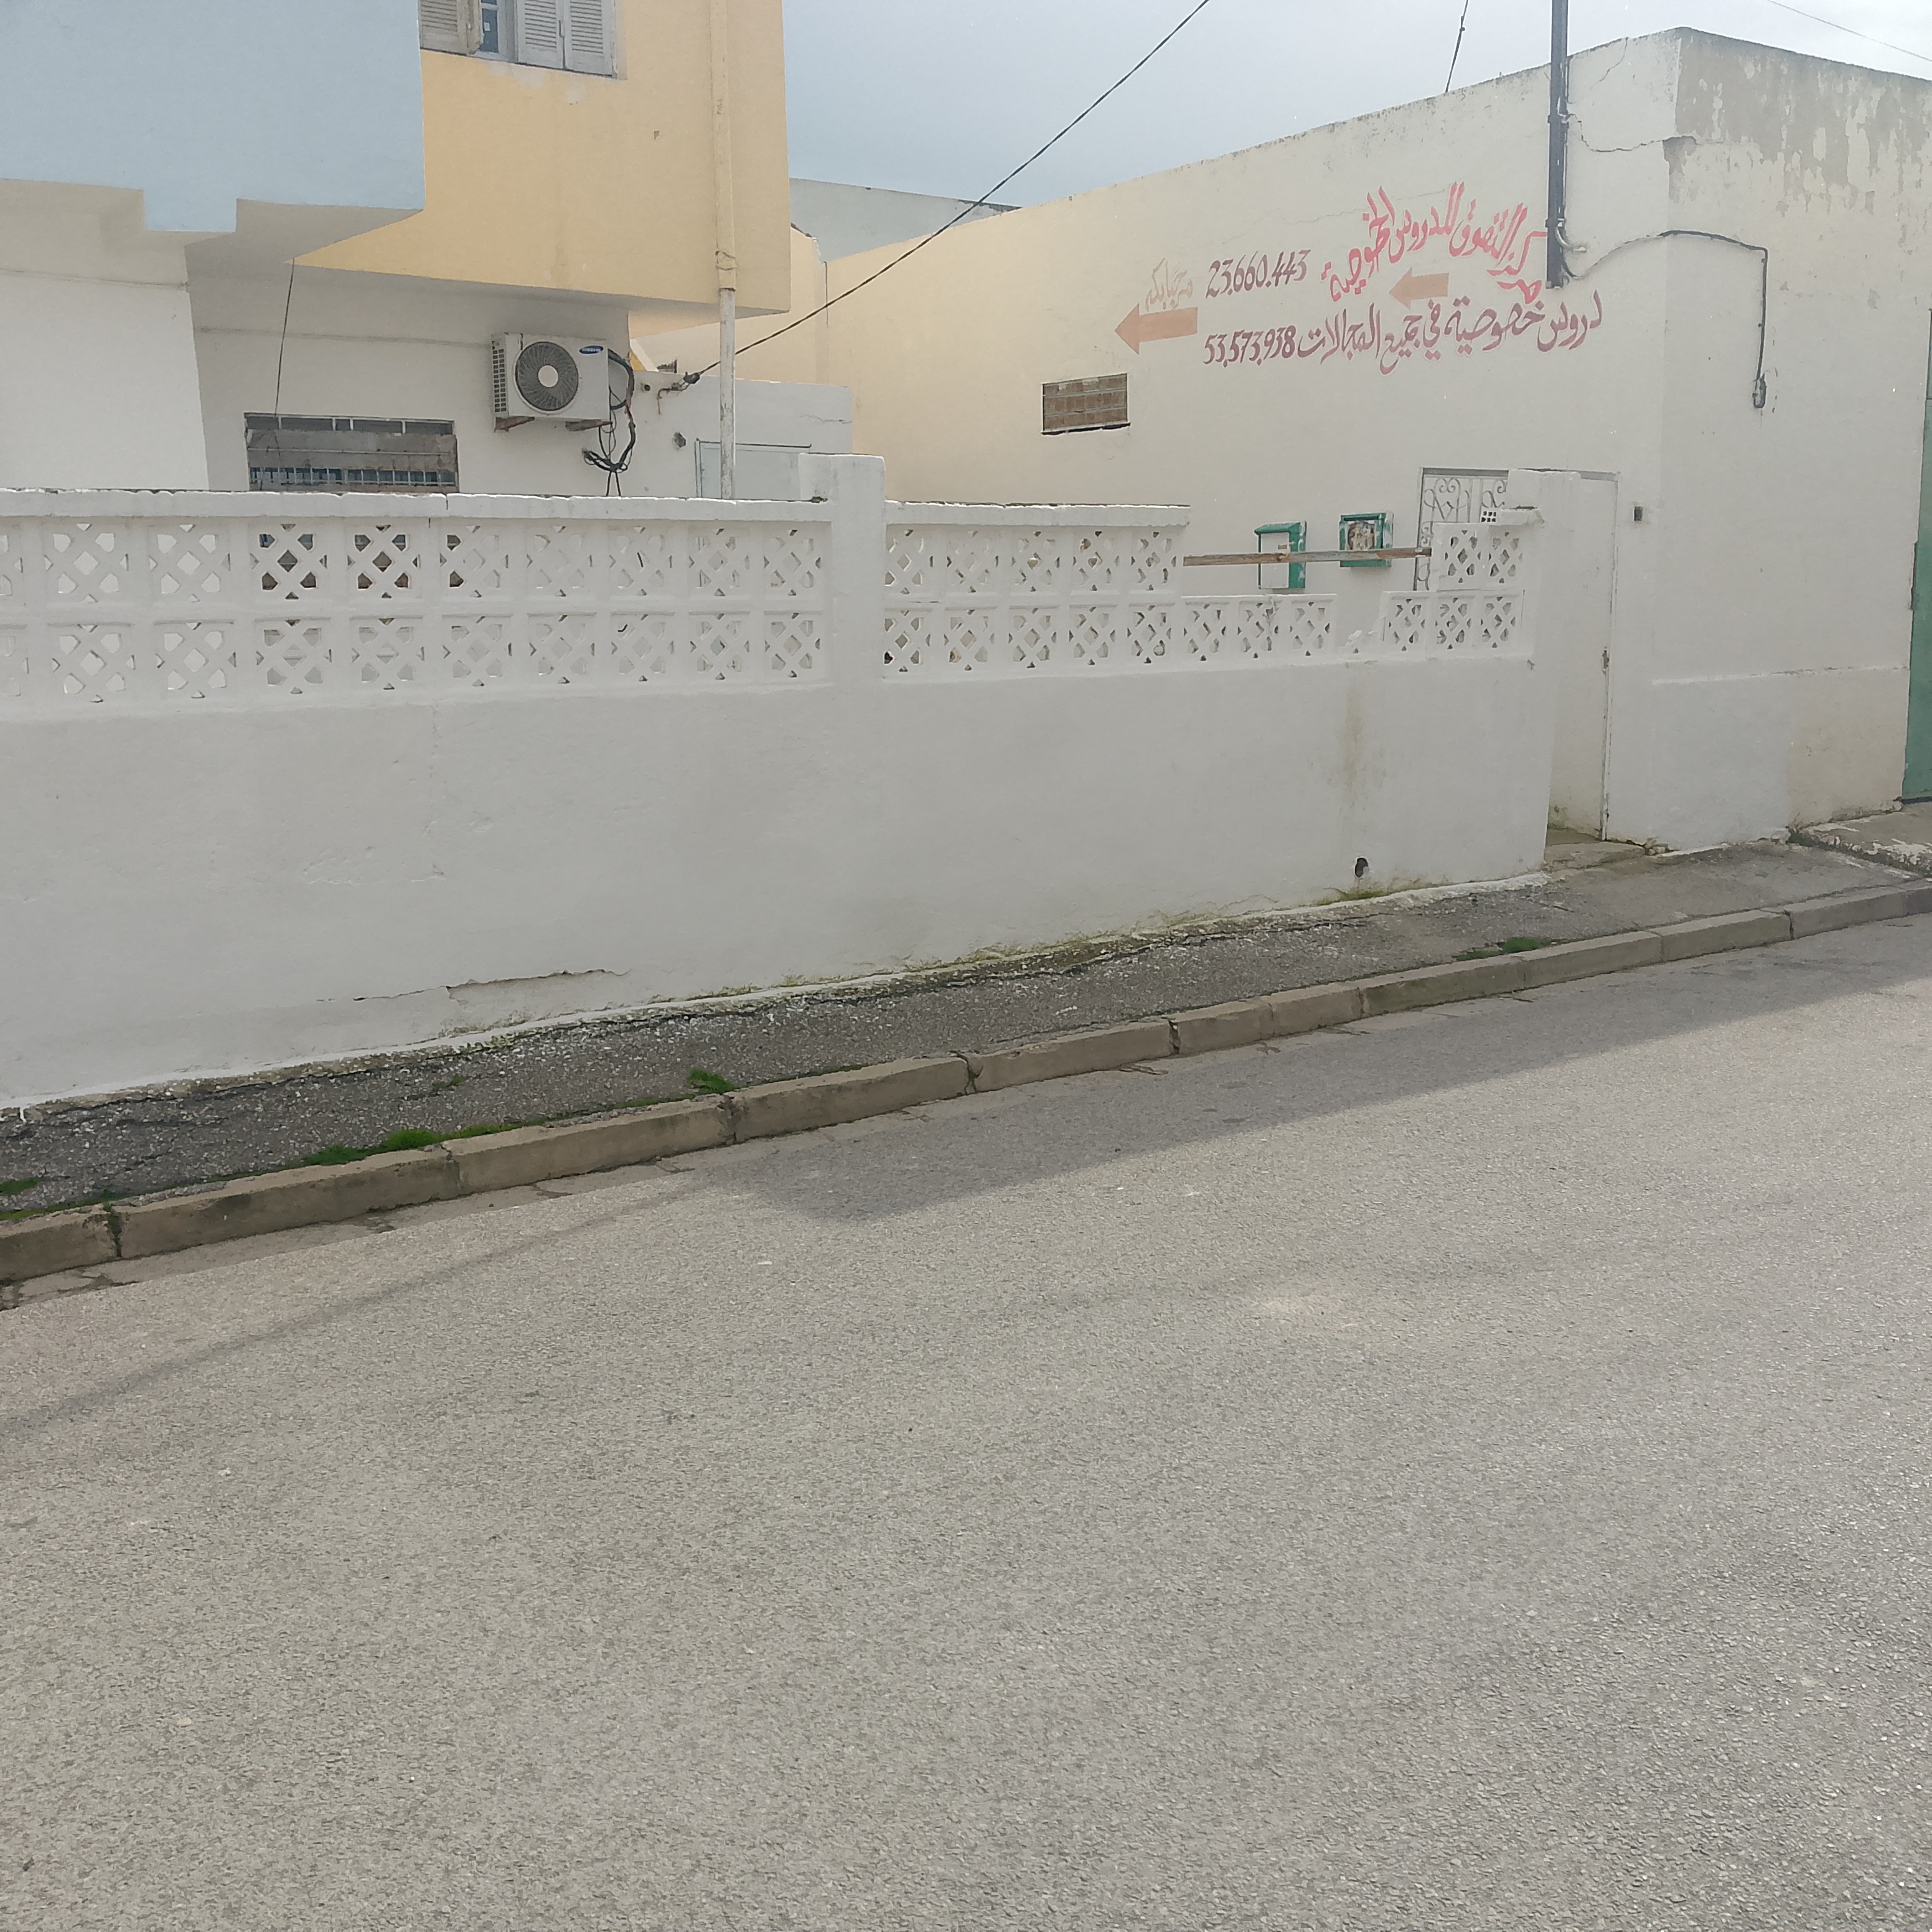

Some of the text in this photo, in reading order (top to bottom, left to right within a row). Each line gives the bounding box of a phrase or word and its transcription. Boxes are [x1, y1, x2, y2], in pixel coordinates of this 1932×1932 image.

[1320, 181, 1547, 304] مركز التفوق للدروس الخصوصية
[1297, 303, 1381, 365] المجالات
[1379, 314, 1423, 375] جميع
[1423, 298, 1442, 361] في
[1444, 296, 1545, 355] خصوصية
[1537, 289, 1603, 352] دروس
